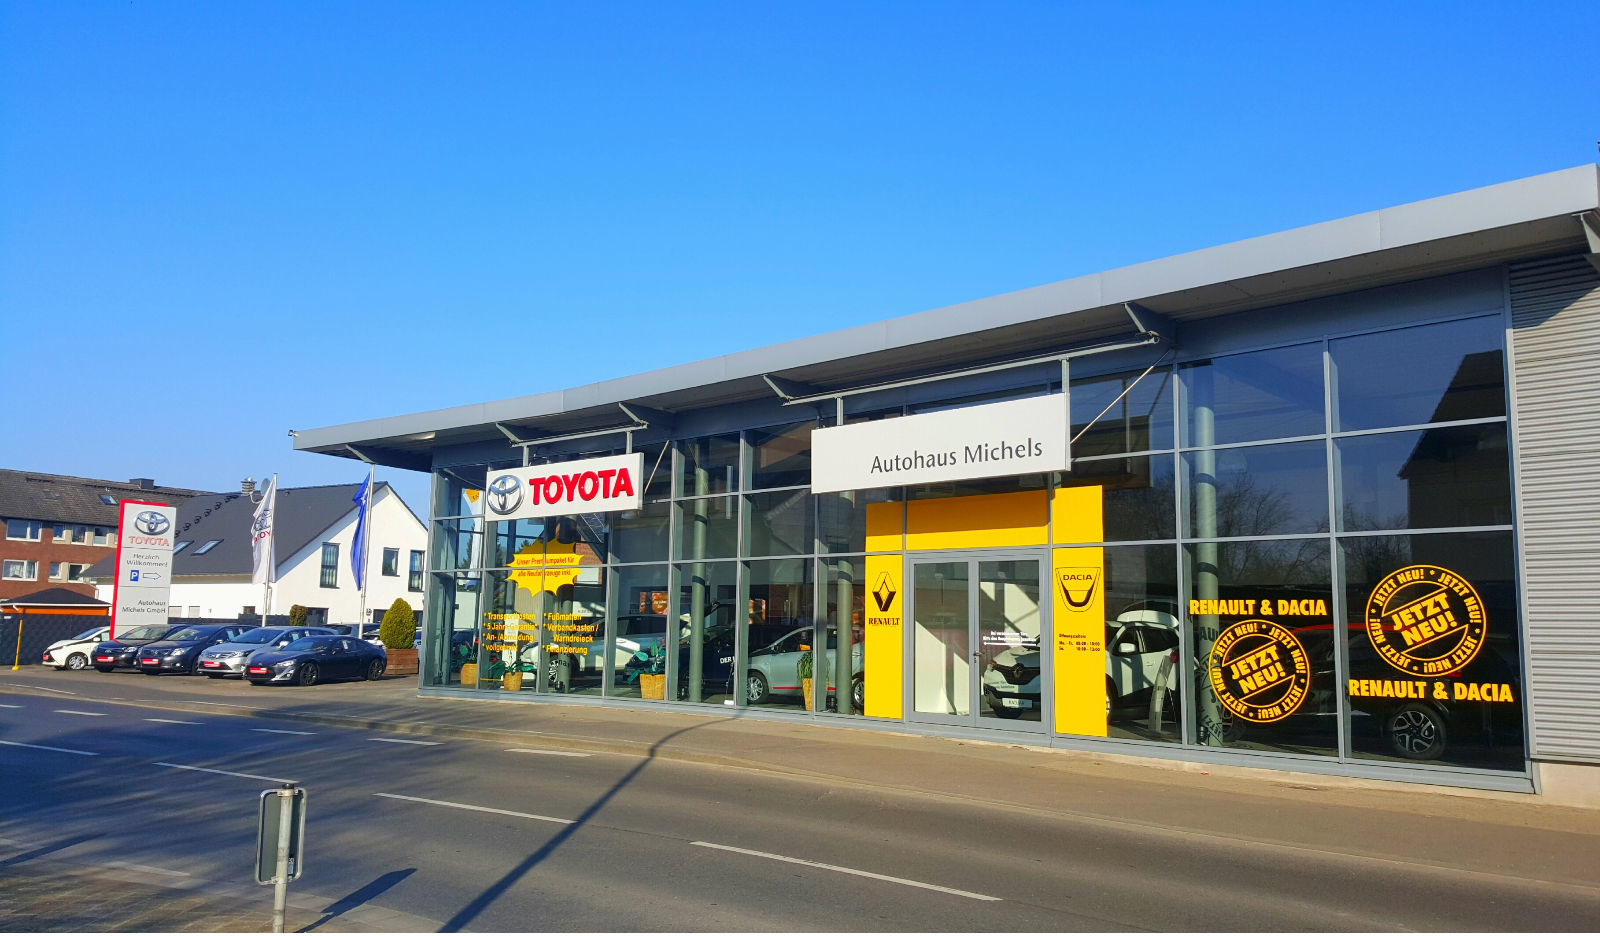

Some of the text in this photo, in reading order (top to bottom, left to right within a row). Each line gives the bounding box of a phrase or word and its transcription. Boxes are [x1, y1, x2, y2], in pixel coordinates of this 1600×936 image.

[870, 438, 1043, 474] Autohaus Michels
[529, 468, 634, 505] TOYOTA
[128, 535, 170, 546] TOYOTA
[532, 557, 566, 565] Premumpaket
[1373, 568, 1424, 607] JETZT NEU!
[1438, 572, 1482, 624] JETZT NEU!
[146, 606, 166, 614] GmbH
[548, 612, 582, 621] Fußmatten
[868, 618, 900, 626] RENAULT
[1190, 600, 1256, 615] RENAULT
[1260, 600, 1274, 616] &
[1278, 600, 1328, 616] DACIA
[1391, 592, 1450, 631] JETZT
[548, 624, 595, 632] Verbandkasten
[553, 634, 594, 643] Warndreieck
[1215, 631, 1236, 658] JETZT
[1234, 622, 1258, 636] NEU!
[1369, 618, 1412, 668] JETZT NEU!
[1400, 610, 1458, 646] NEU!
[546, 644, 588, 656] Finanzierung
[1230, 645, 1280, 680] JETZT
[1268, 626, 1306, 674] JETZT NEU!
[1423, 635, 1478, 674] JETZT NEU!
[1212, 668, 1248, 714] JETZT NEU!
[1238, 662, 1286, 694] NEU!
[1348, 680, 1514, 703] RENAULT & DACIA
[1258, 684, 1303, 719] JETZT NEU!
